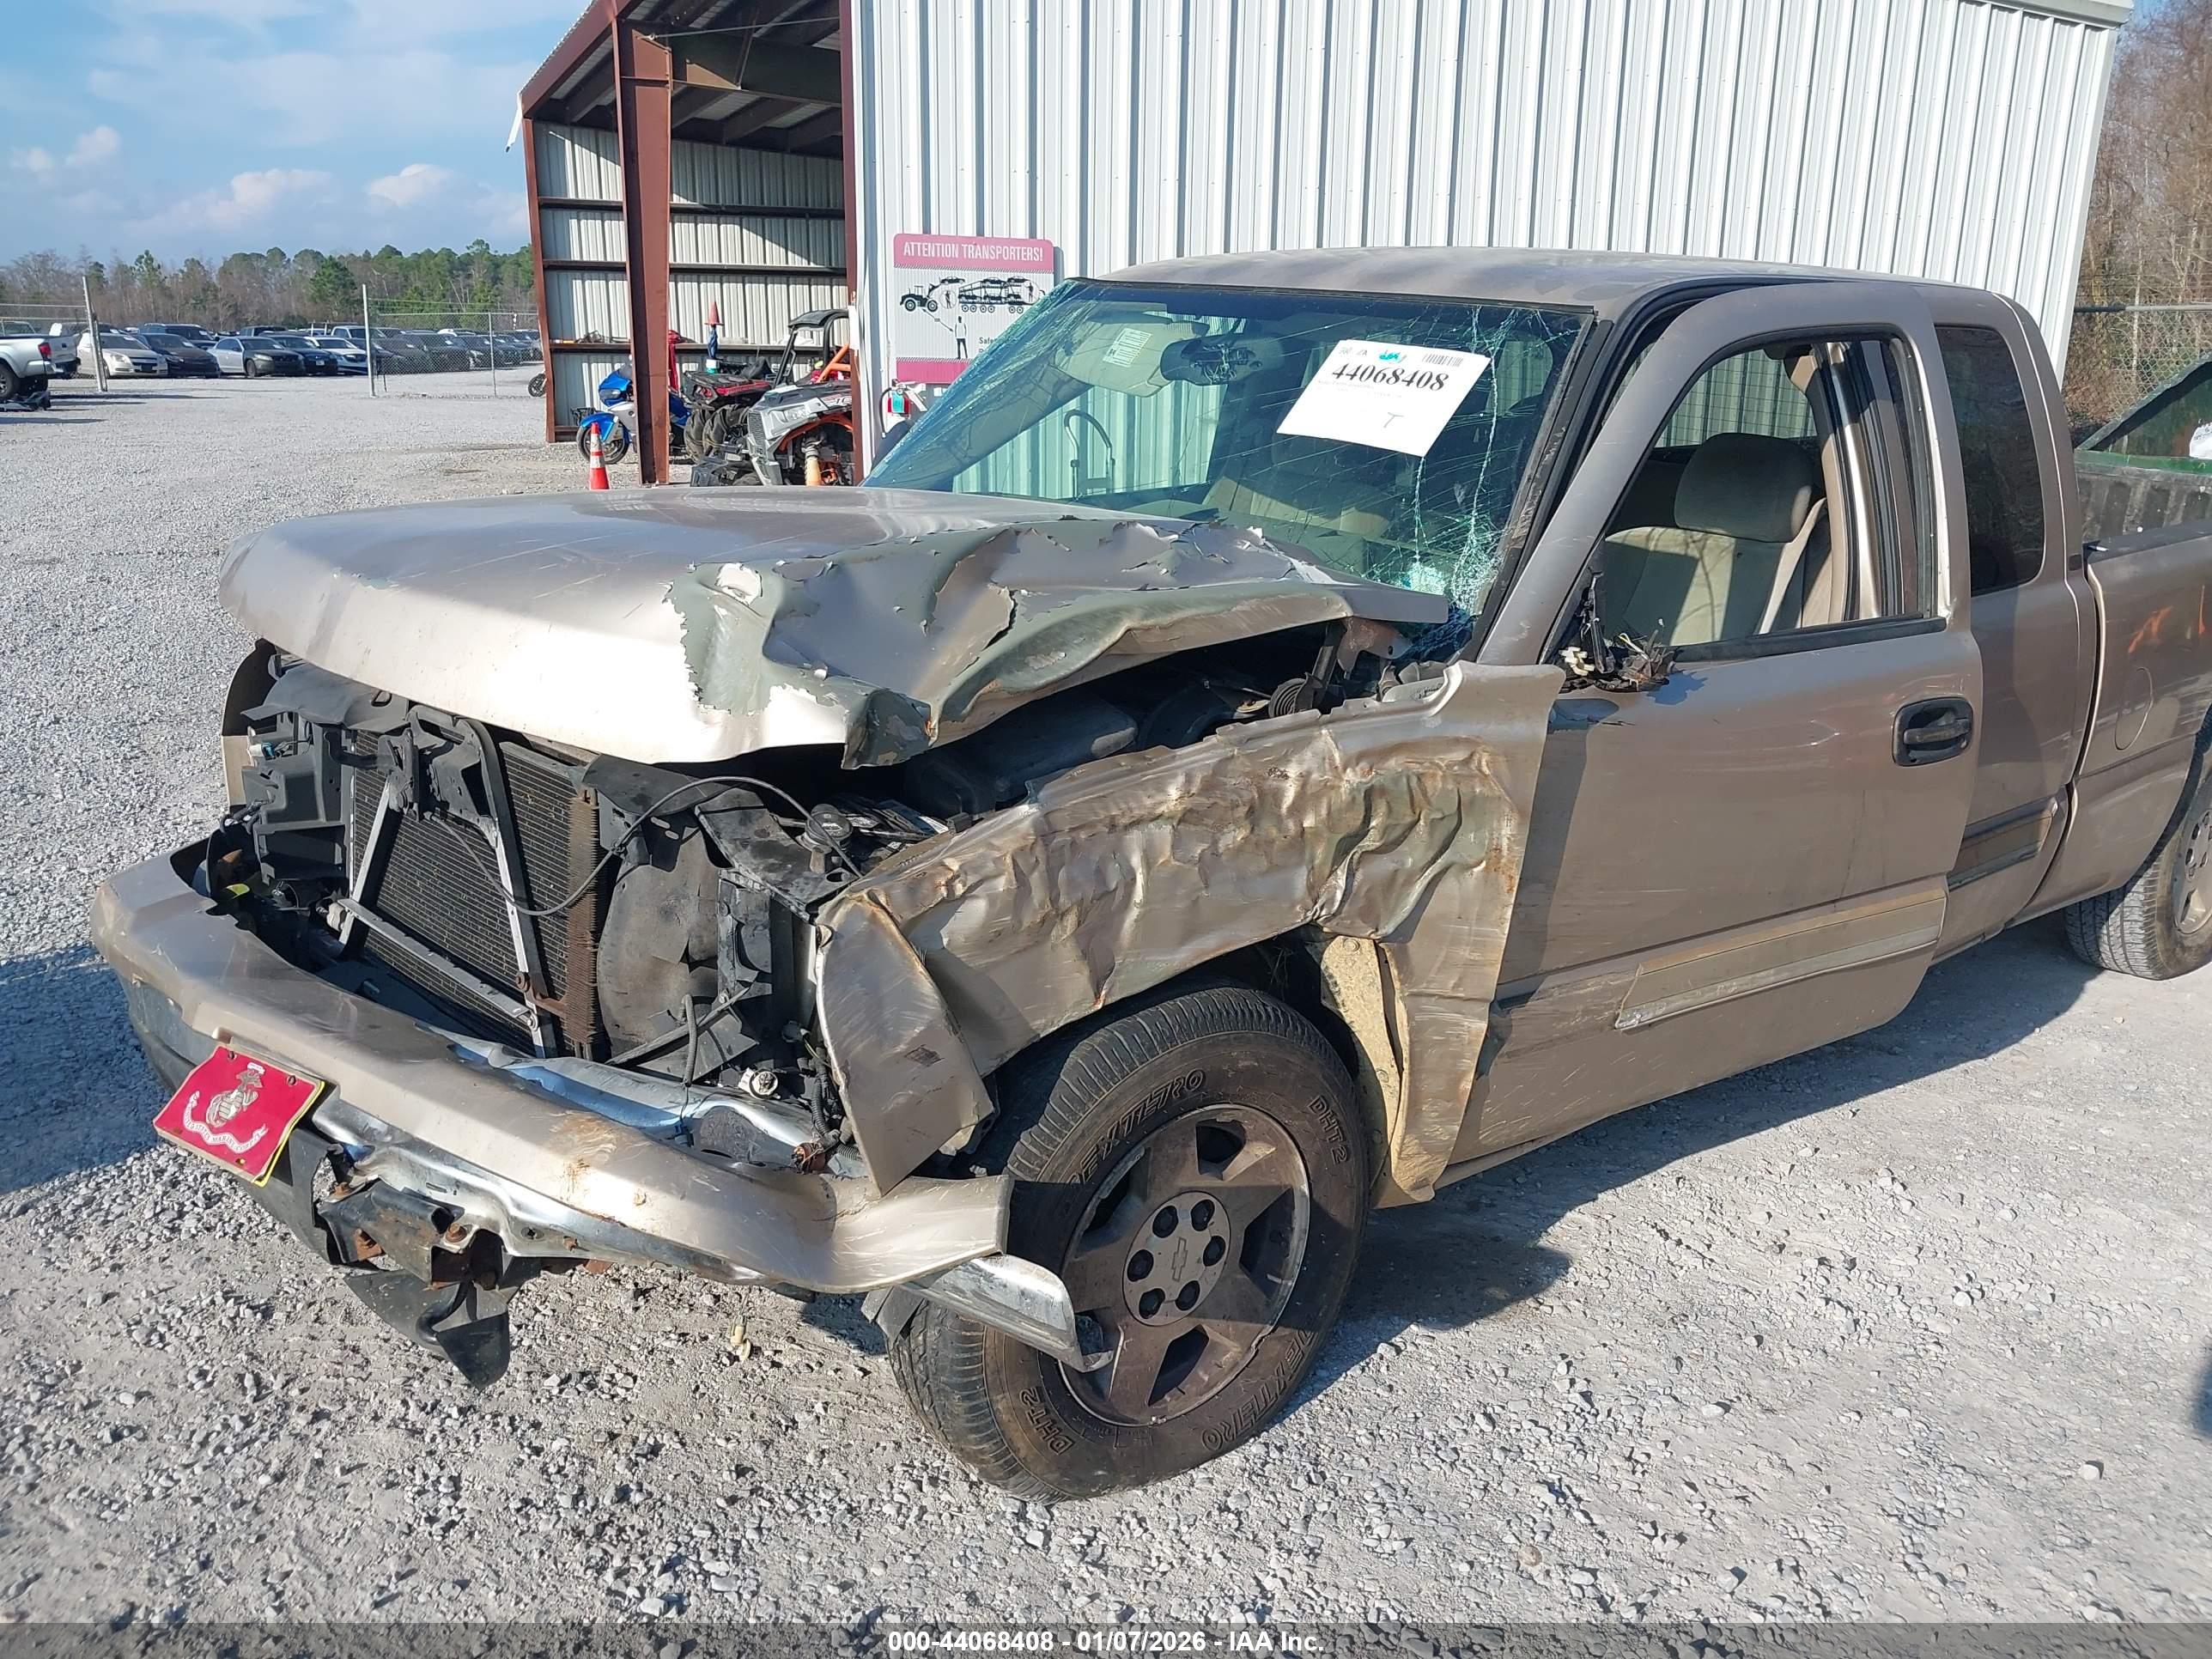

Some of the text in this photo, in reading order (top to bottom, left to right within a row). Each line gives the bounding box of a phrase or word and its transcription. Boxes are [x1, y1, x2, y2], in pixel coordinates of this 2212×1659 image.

[903, 241, 1043, 262] ATTENTION TRANSPORTERS!
[1332, 362, 1449, 392] 44068408
